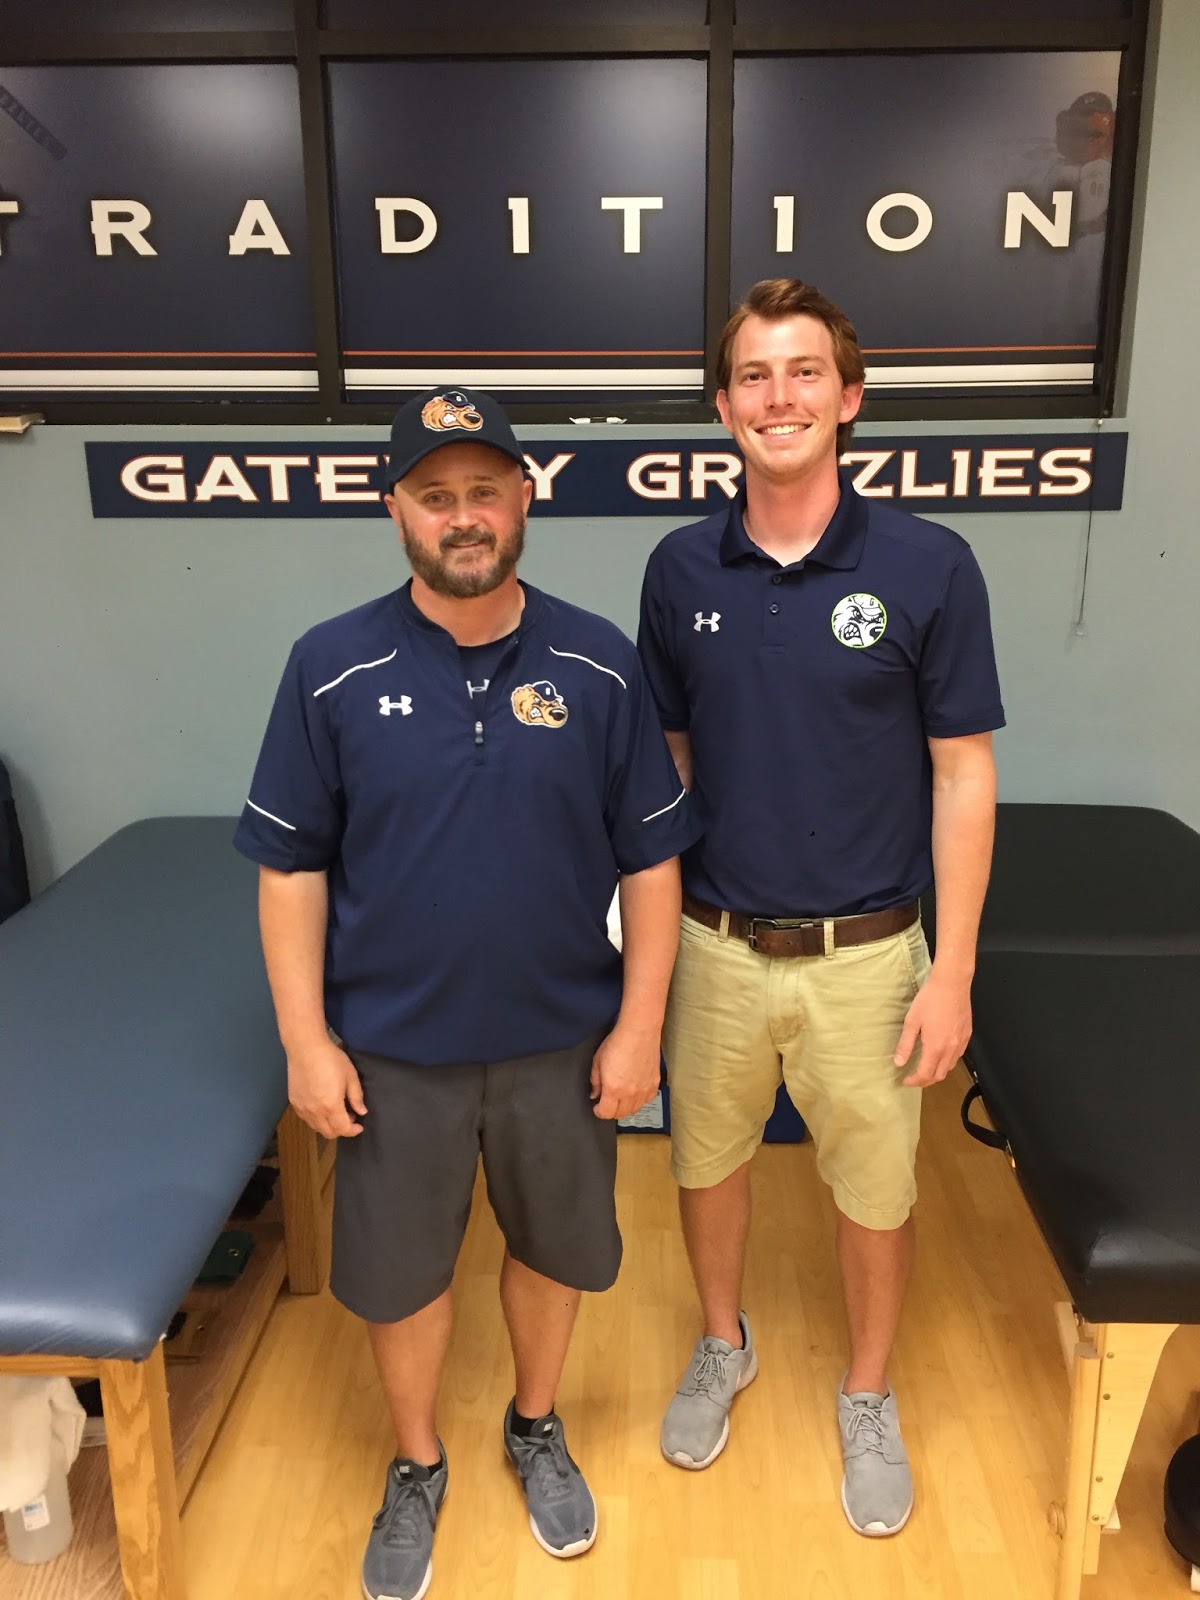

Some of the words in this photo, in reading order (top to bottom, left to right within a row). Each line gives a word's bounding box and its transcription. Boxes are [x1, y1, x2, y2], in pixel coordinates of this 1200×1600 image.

[0, 192, 1073, 256] RADITION
[120, 452, 576, 501] GATEY
[627, 447, 1093, 500] GRZLIES
